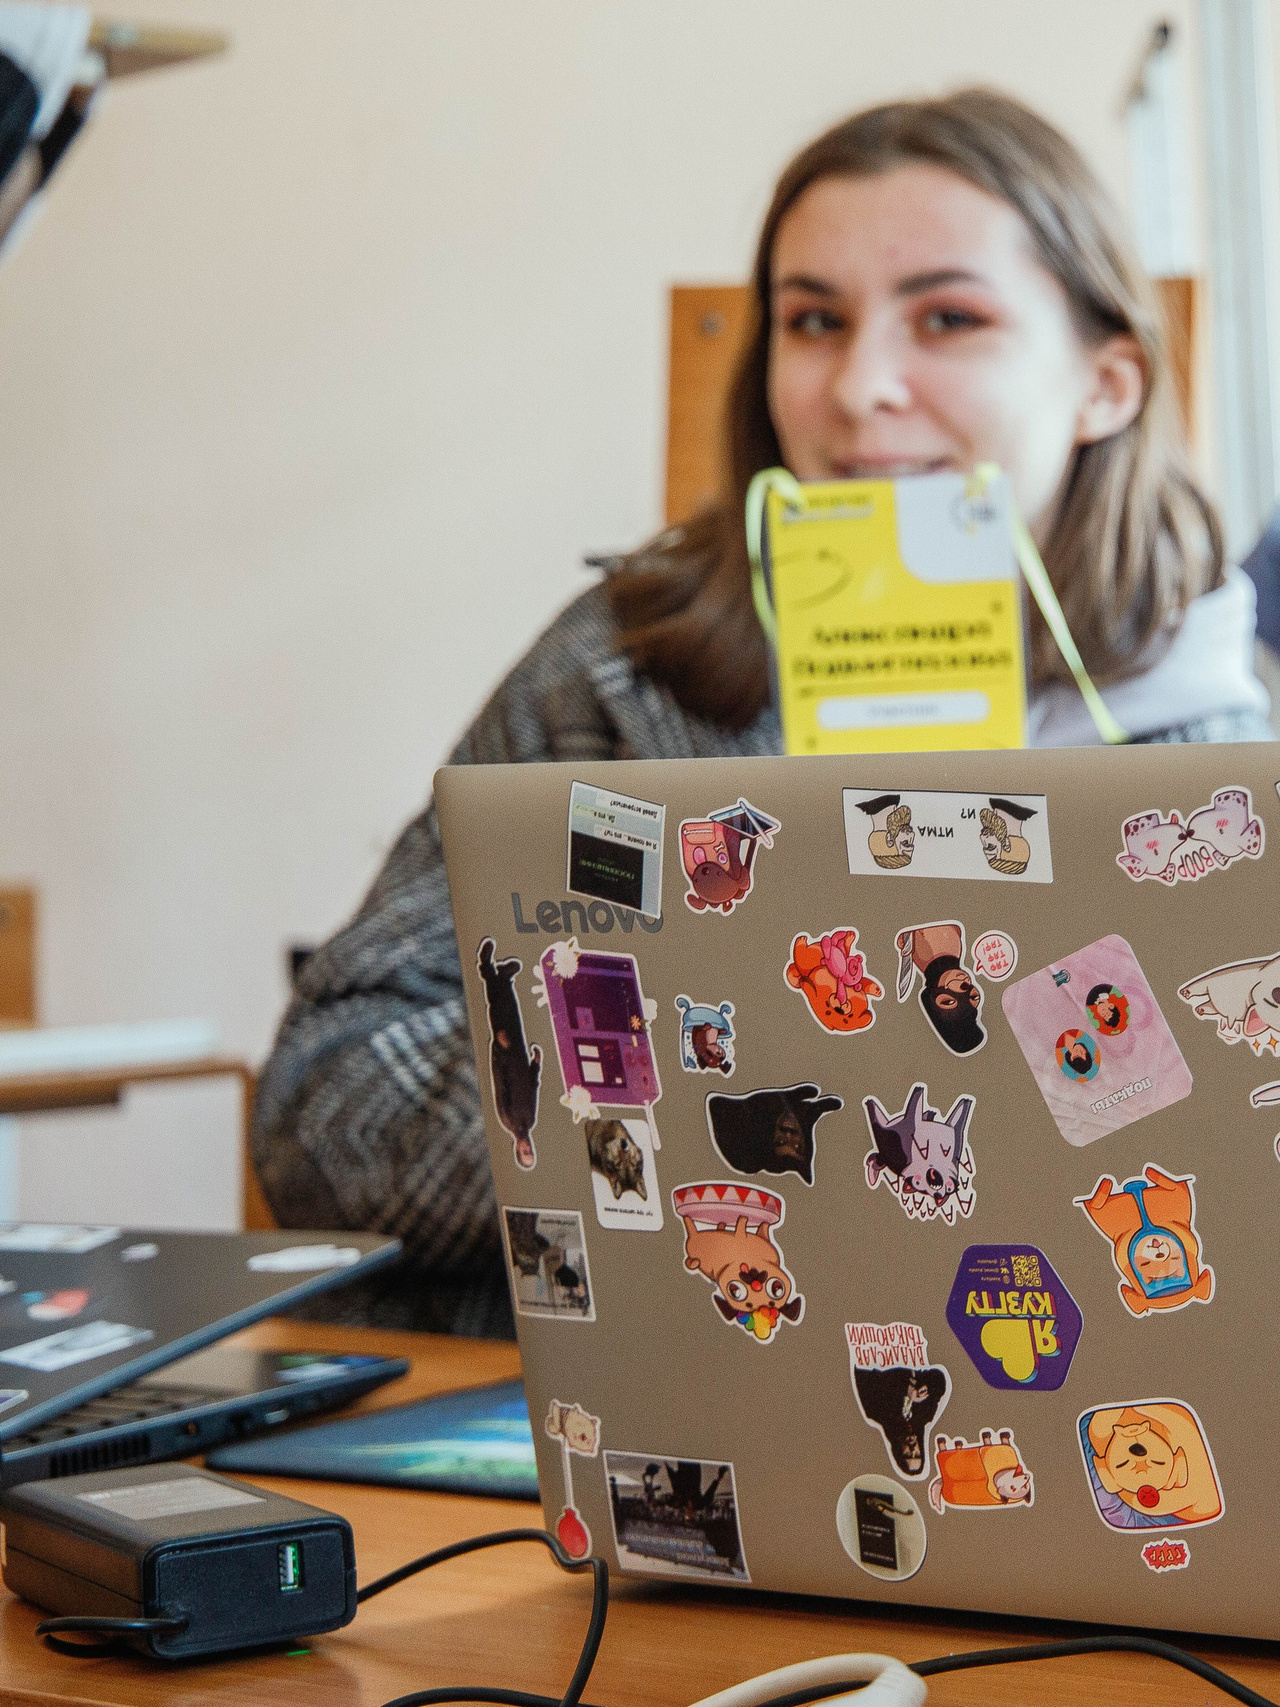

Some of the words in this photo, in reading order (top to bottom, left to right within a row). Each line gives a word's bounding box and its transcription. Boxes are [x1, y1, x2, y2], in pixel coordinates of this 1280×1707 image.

[960, 808, 976, 819] И?
[917, 826, 953, 838] ИТМА
[1177, 846, 1214, 878] BOOP
[511, 892, 664, 934] Lenovo
[965, 1291, 1057, 1318] КУЗГТУ
[846, 1324, 924, 1346] ТЫКАЮЩИЙ
[1032, 1319, 1061, 1357] Я
[855, 1344, 925, 1367] ВЛАДИСЛАВ
